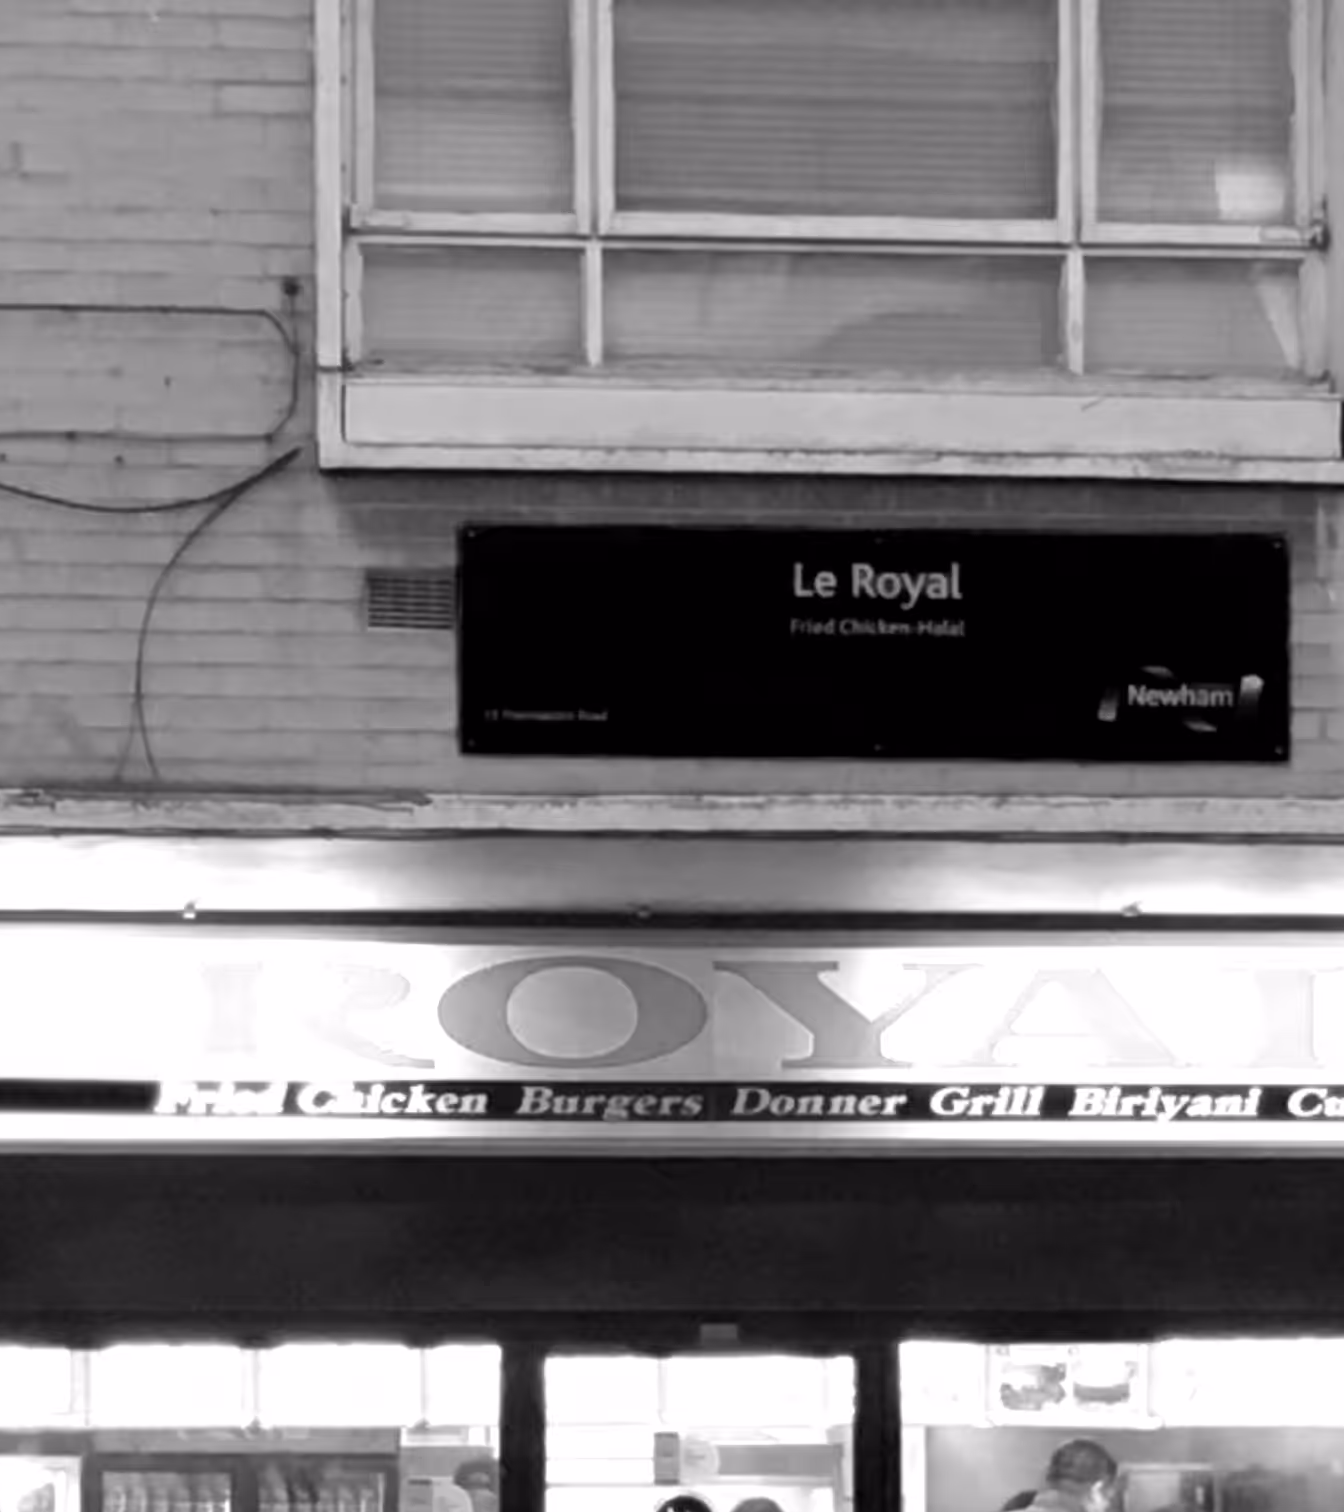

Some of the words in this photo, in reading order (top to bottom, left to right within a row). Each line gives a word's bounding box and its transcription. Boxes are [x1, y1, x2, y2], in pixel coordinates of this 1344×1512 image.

[794, 562, 837, 598] Le
[852, 562, 962, 610] Royal
[789, 617, 836, 635] Fried
[1128, 683, 1233, 707] Newham
[296, 1082, 488, 1115] Chicken
[515, 1085, 704, 1122] Burgers
[730, 1086, 908, 1116] Donner
[929, 1085, 1044, 1117] Grill
[1067, 1085, 1262, 1122] Biriyani
